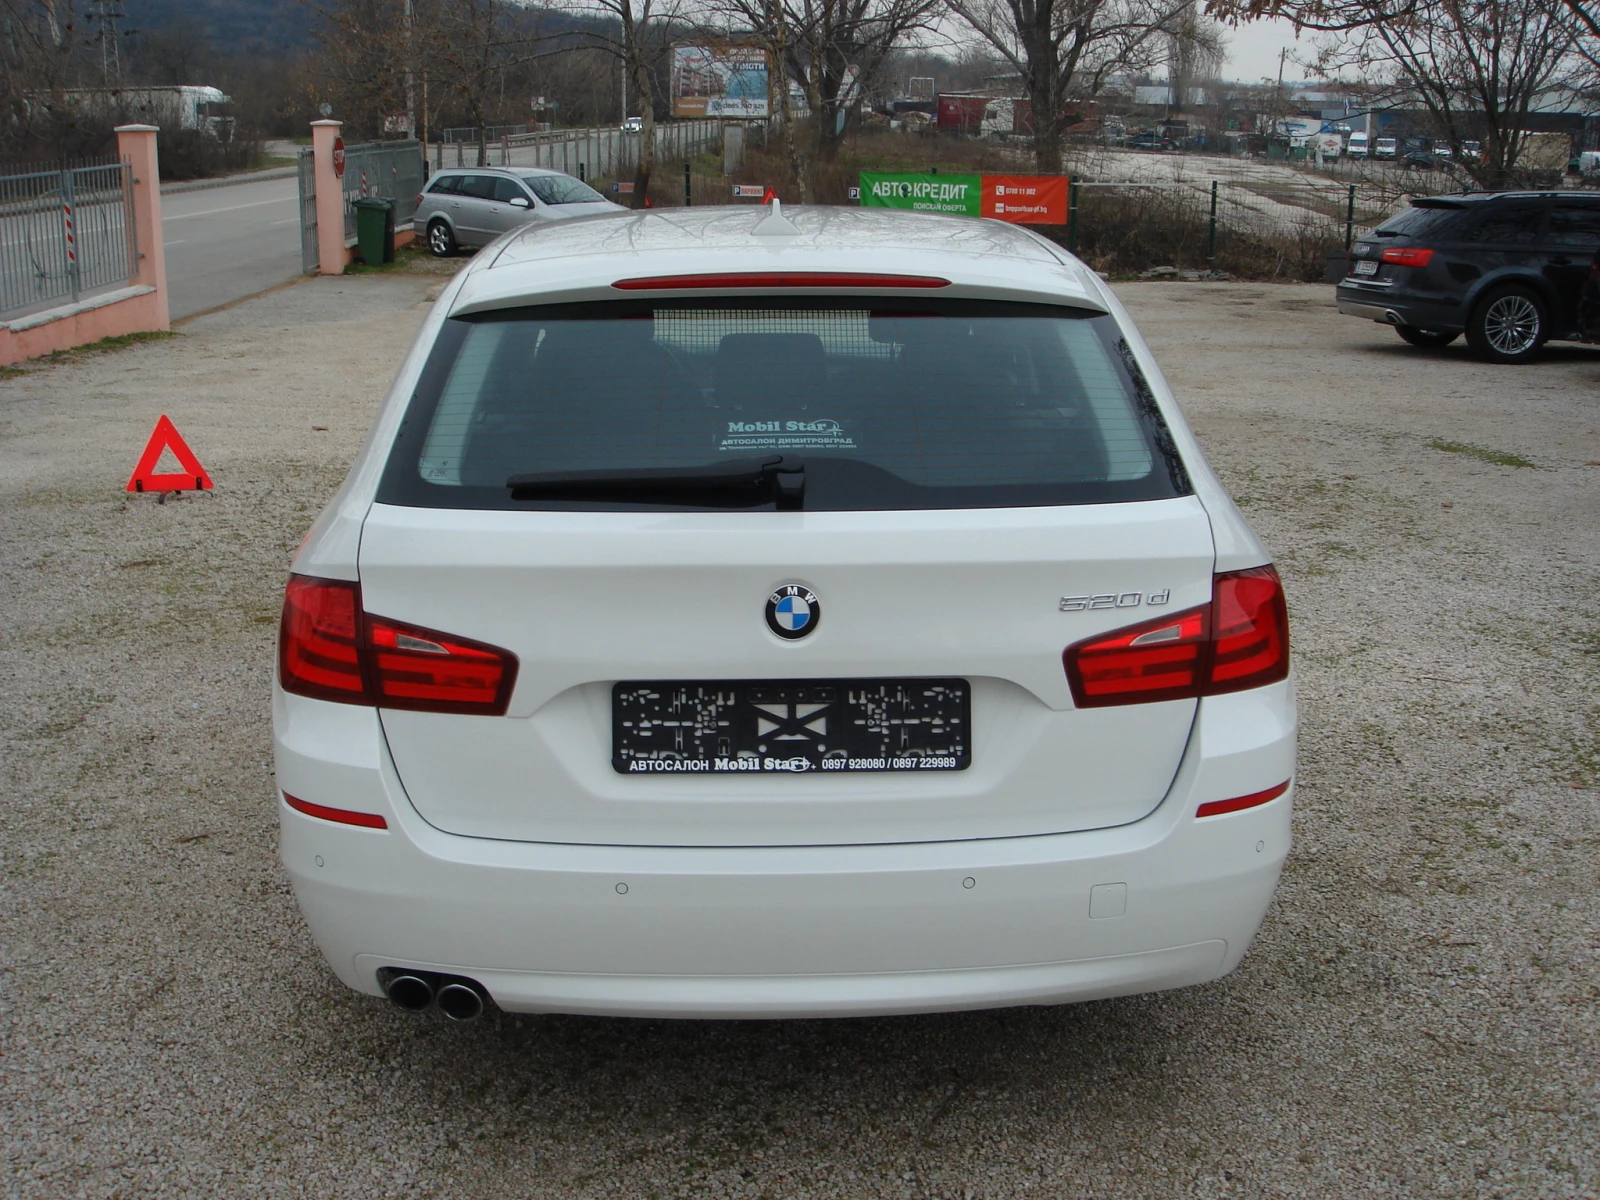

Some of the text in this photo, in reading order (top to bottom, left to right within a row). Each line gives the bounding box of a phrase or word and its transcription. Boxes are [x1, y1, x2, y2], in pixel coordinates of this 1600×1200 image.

[334, 150, 345, 164] STOP
[913, 202, 967, 212] ПОИСКАЙ ОФЕРТА
[727, 420, 827, 433] Mobil Star
[778, 437, 853, 445] ДИМИТРОВГРАД
[770, 586, 817, 605] BMW
[629, 760, 709, 771] АВТОСАЛОН
[714, 757, 760, 771] Mobil
[763, 757, 799, 771] Star
[822, 758, 847, 770] 0897
[849, 758, 885, 770] 928080
[893, 757, 917, 769] 0897
[919, 757, 956, 769] 229989
